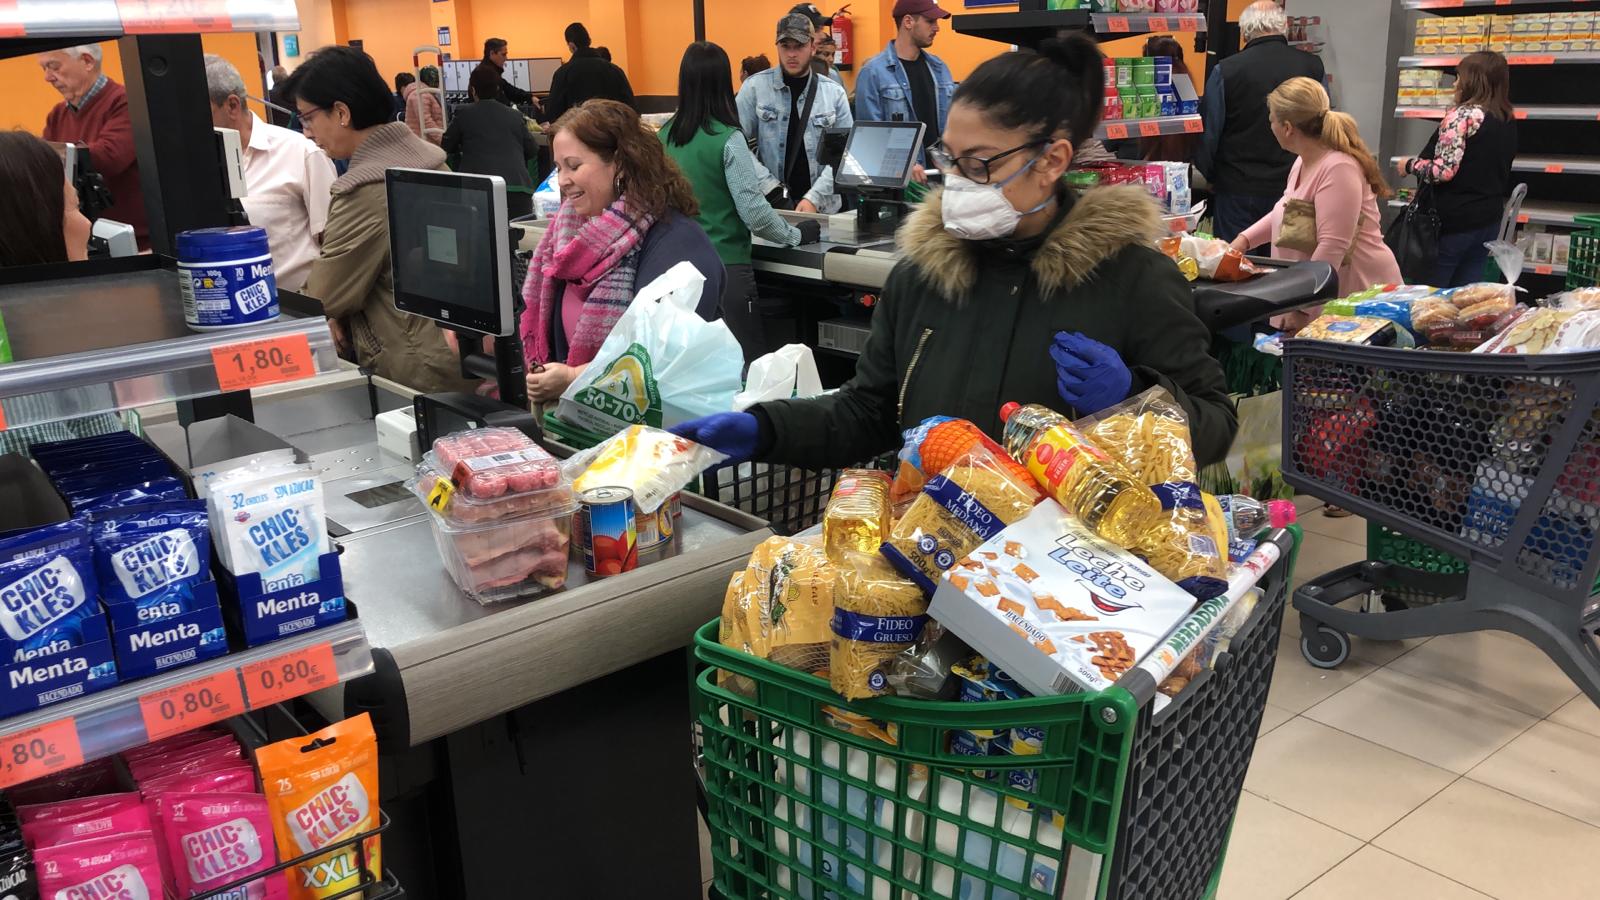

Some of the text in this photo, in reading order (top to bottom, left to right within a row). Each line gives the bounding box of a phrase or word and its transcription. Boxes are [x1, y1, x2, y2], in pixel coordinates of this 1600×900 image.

[244, 293, 268, 312] KLES
[233, 347, 293, 376] 1,80€
[231, 493, 245, 510] 32
[956, 490, 993, 524] FIDEO
[104, 520, 117, 532] 32
[249, 508, 299, 547] CHIC
[944, 499, 989, 537] MEDIANO
[260, 525, 310, 568] KLES
[1055, 533, 1146, 592] Leche
[261, 574, 306, 595] enta
[1047, 546, 1127, 599] Leite
[1, 567, 59, 613] CHIC
[256, 592, 320, 619] Menta
[14, 586, 75, 635] KLES
[137, 602, 181, 621] enta
[877, 617, 914, 631] FIDEO
[1004, 610, 1046, 642] HACENDADO
[1167, 594, 1231, 657] MERCADONA
[129, 623, 201, 652] Menta
[873, 632, 914, 642] GRUESO
[9, 657, 89, 688] Menta
[261, 660, 318, 690] 0,80€
[160, 688, 222, 721] 0,80€
[277, 778, 292, 792] 25
[296, 785, 347, 831] CHIC
[307, 800, 360, 850] KLES
[187, 825, 239, 858] CHIC
[44, 861, 58, 874] 32
[194, 843, 250, 880] KLES
[301, 853, 360, 888] XXL
